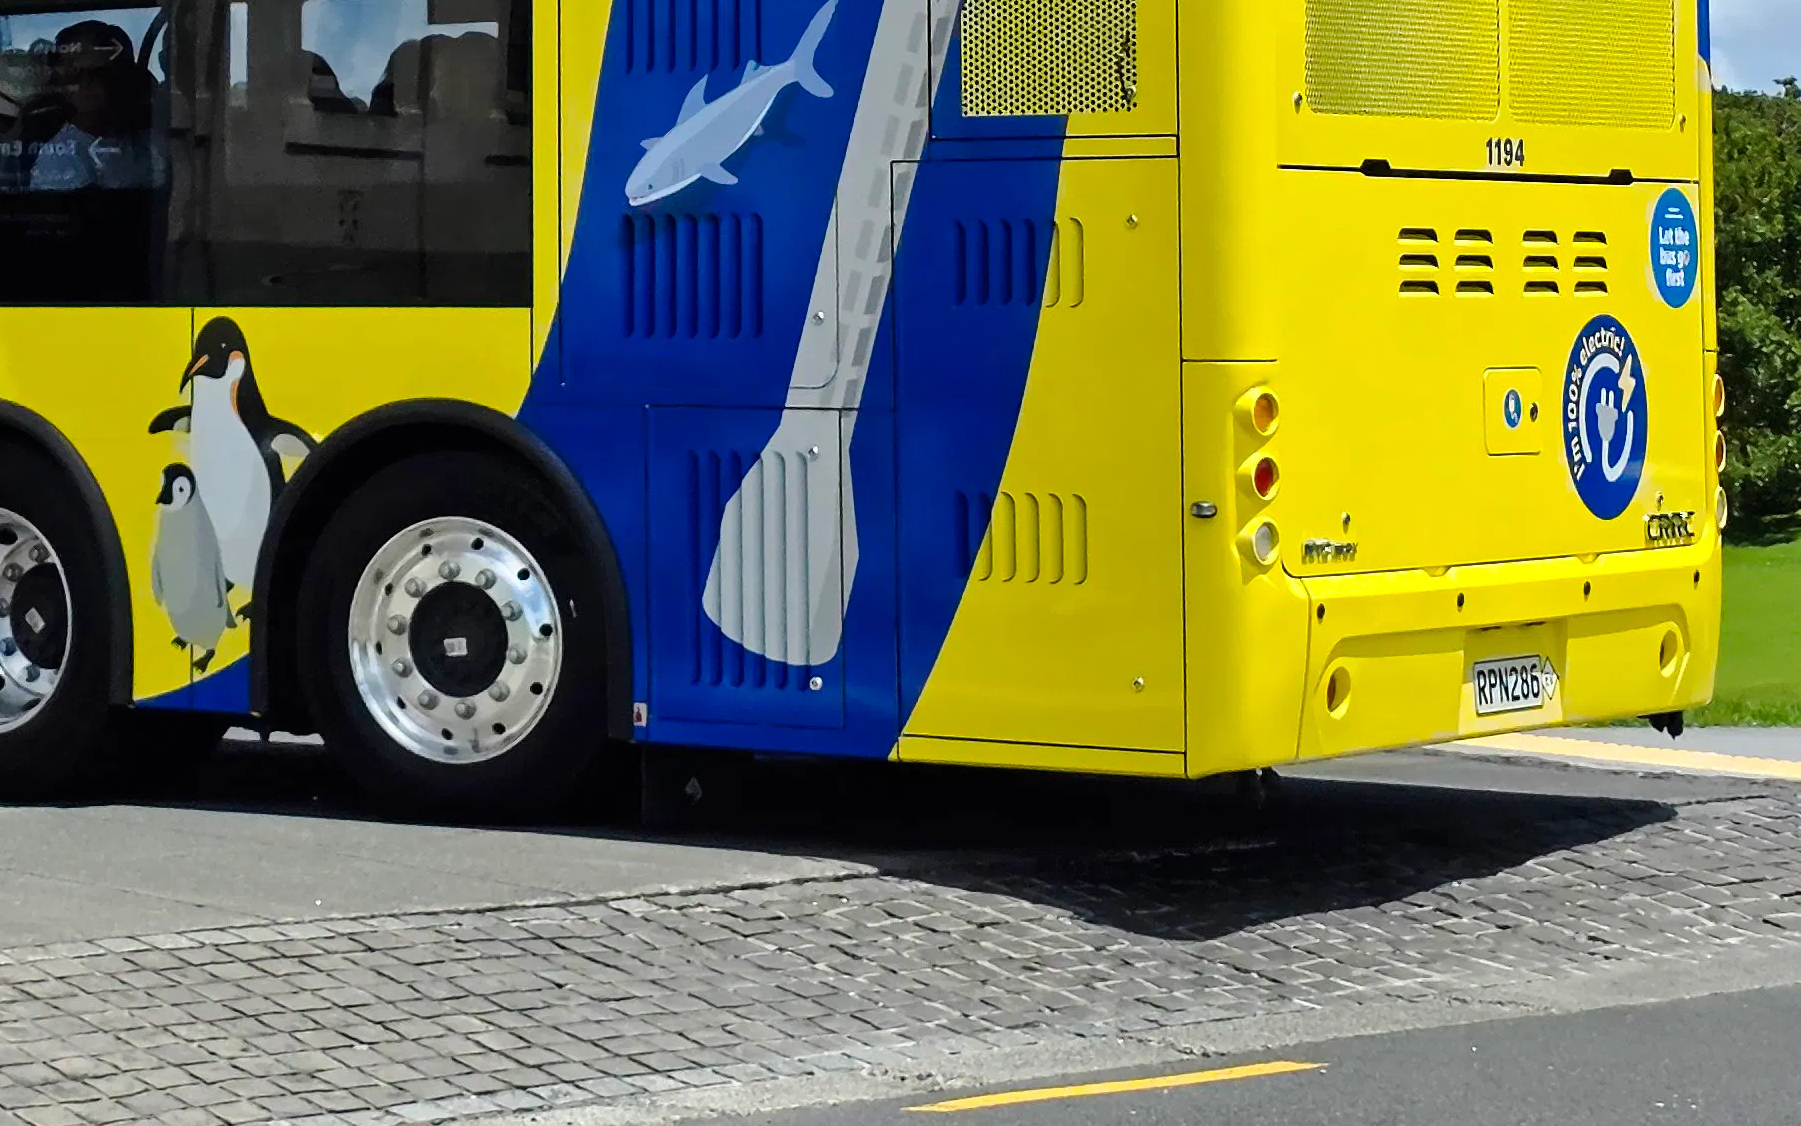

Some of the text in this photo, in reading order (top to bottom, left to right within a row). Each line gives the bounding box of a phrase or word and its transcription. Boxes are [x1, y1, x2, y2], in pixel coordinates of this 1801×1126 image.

[1485, 137, 1526, 168] 1194
[1579, 326, 1626, 367] electric!
[1476, 663, 1541, 706] RPN286
